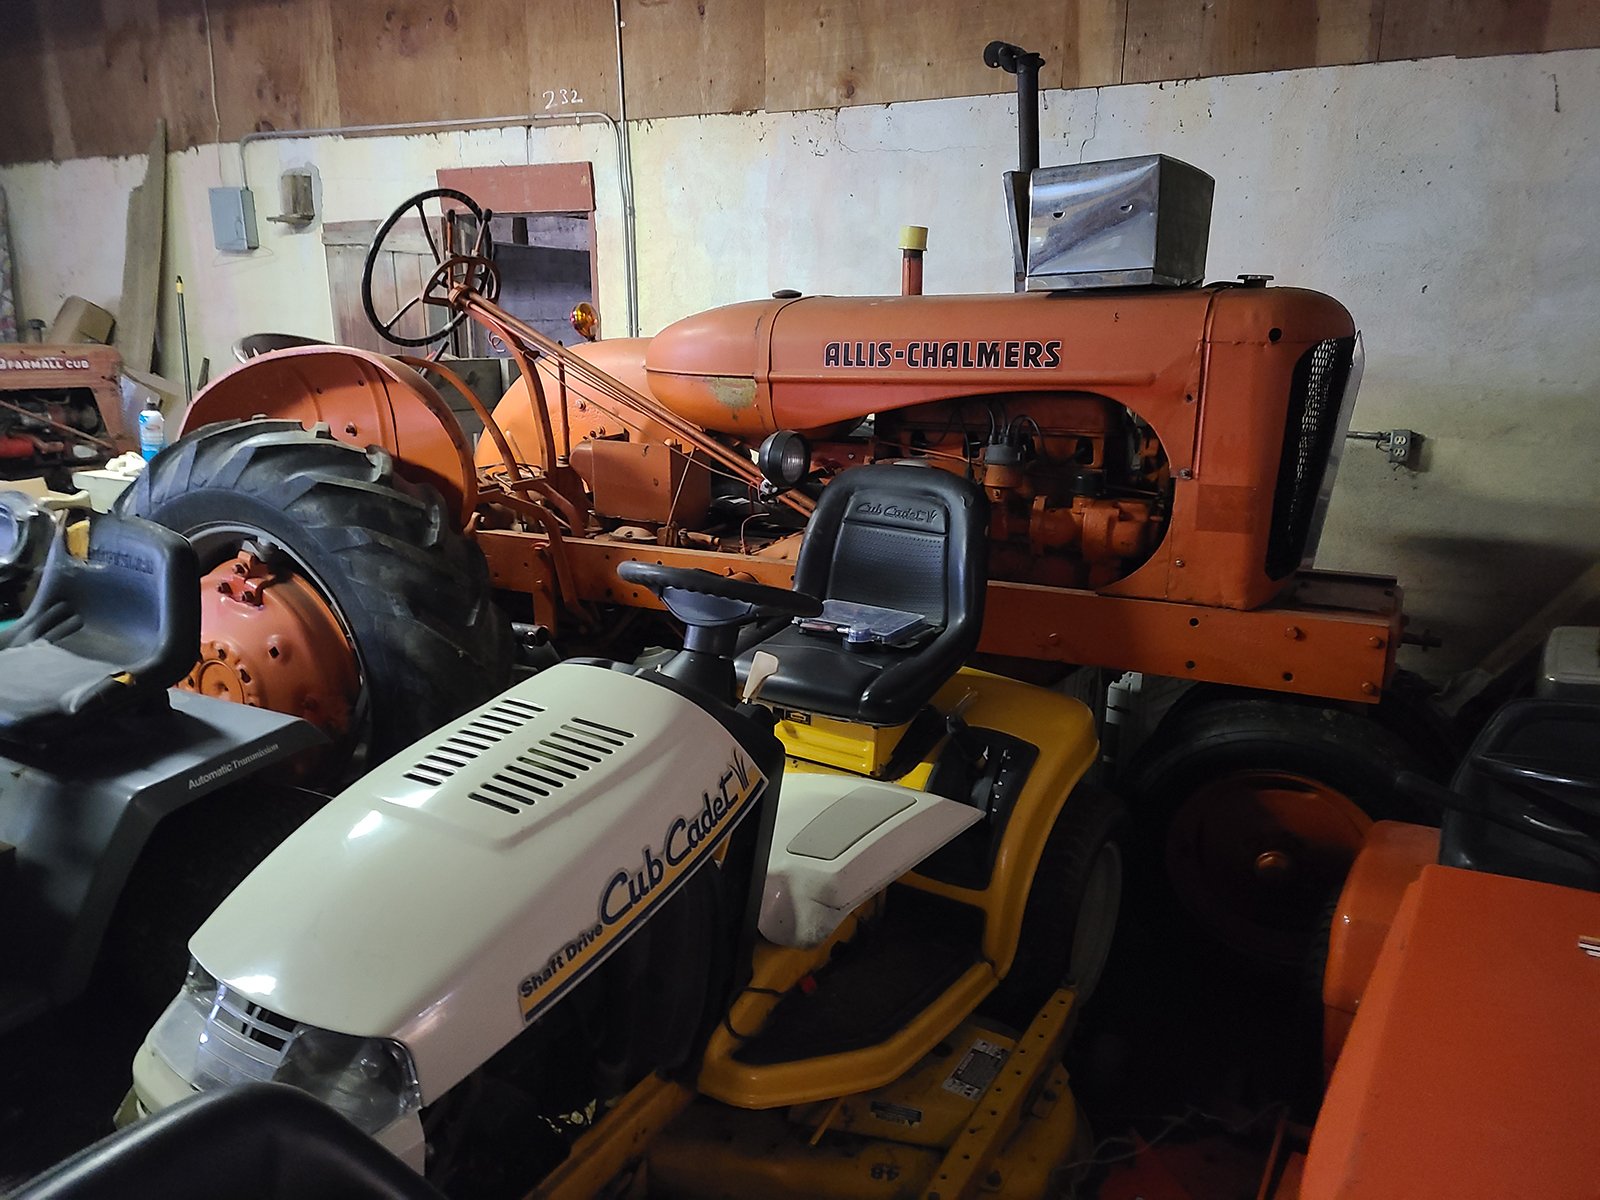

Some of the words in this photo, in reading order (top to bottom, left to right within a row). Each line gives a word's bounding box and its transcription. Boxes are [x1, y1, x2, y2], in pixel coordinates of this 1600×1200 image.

[542, 88, 584, 110] 232
[7, 359, 63, 370] FARMALL
[65, 359, 90, 369] CUB
[824, 340, 1062, 369] ALLIS-CHALMERS
[856, 502, 882, 516] Cub
[884, 505, 927, 521] Cadet
[188, 763, 233, 790] Automatic
[601, 848, 665, 925] Cub
[665, 771, 739, 867] Cadet
[520, 953, 564, 998] Shaft
[566, 923, 603, 962] Drive
